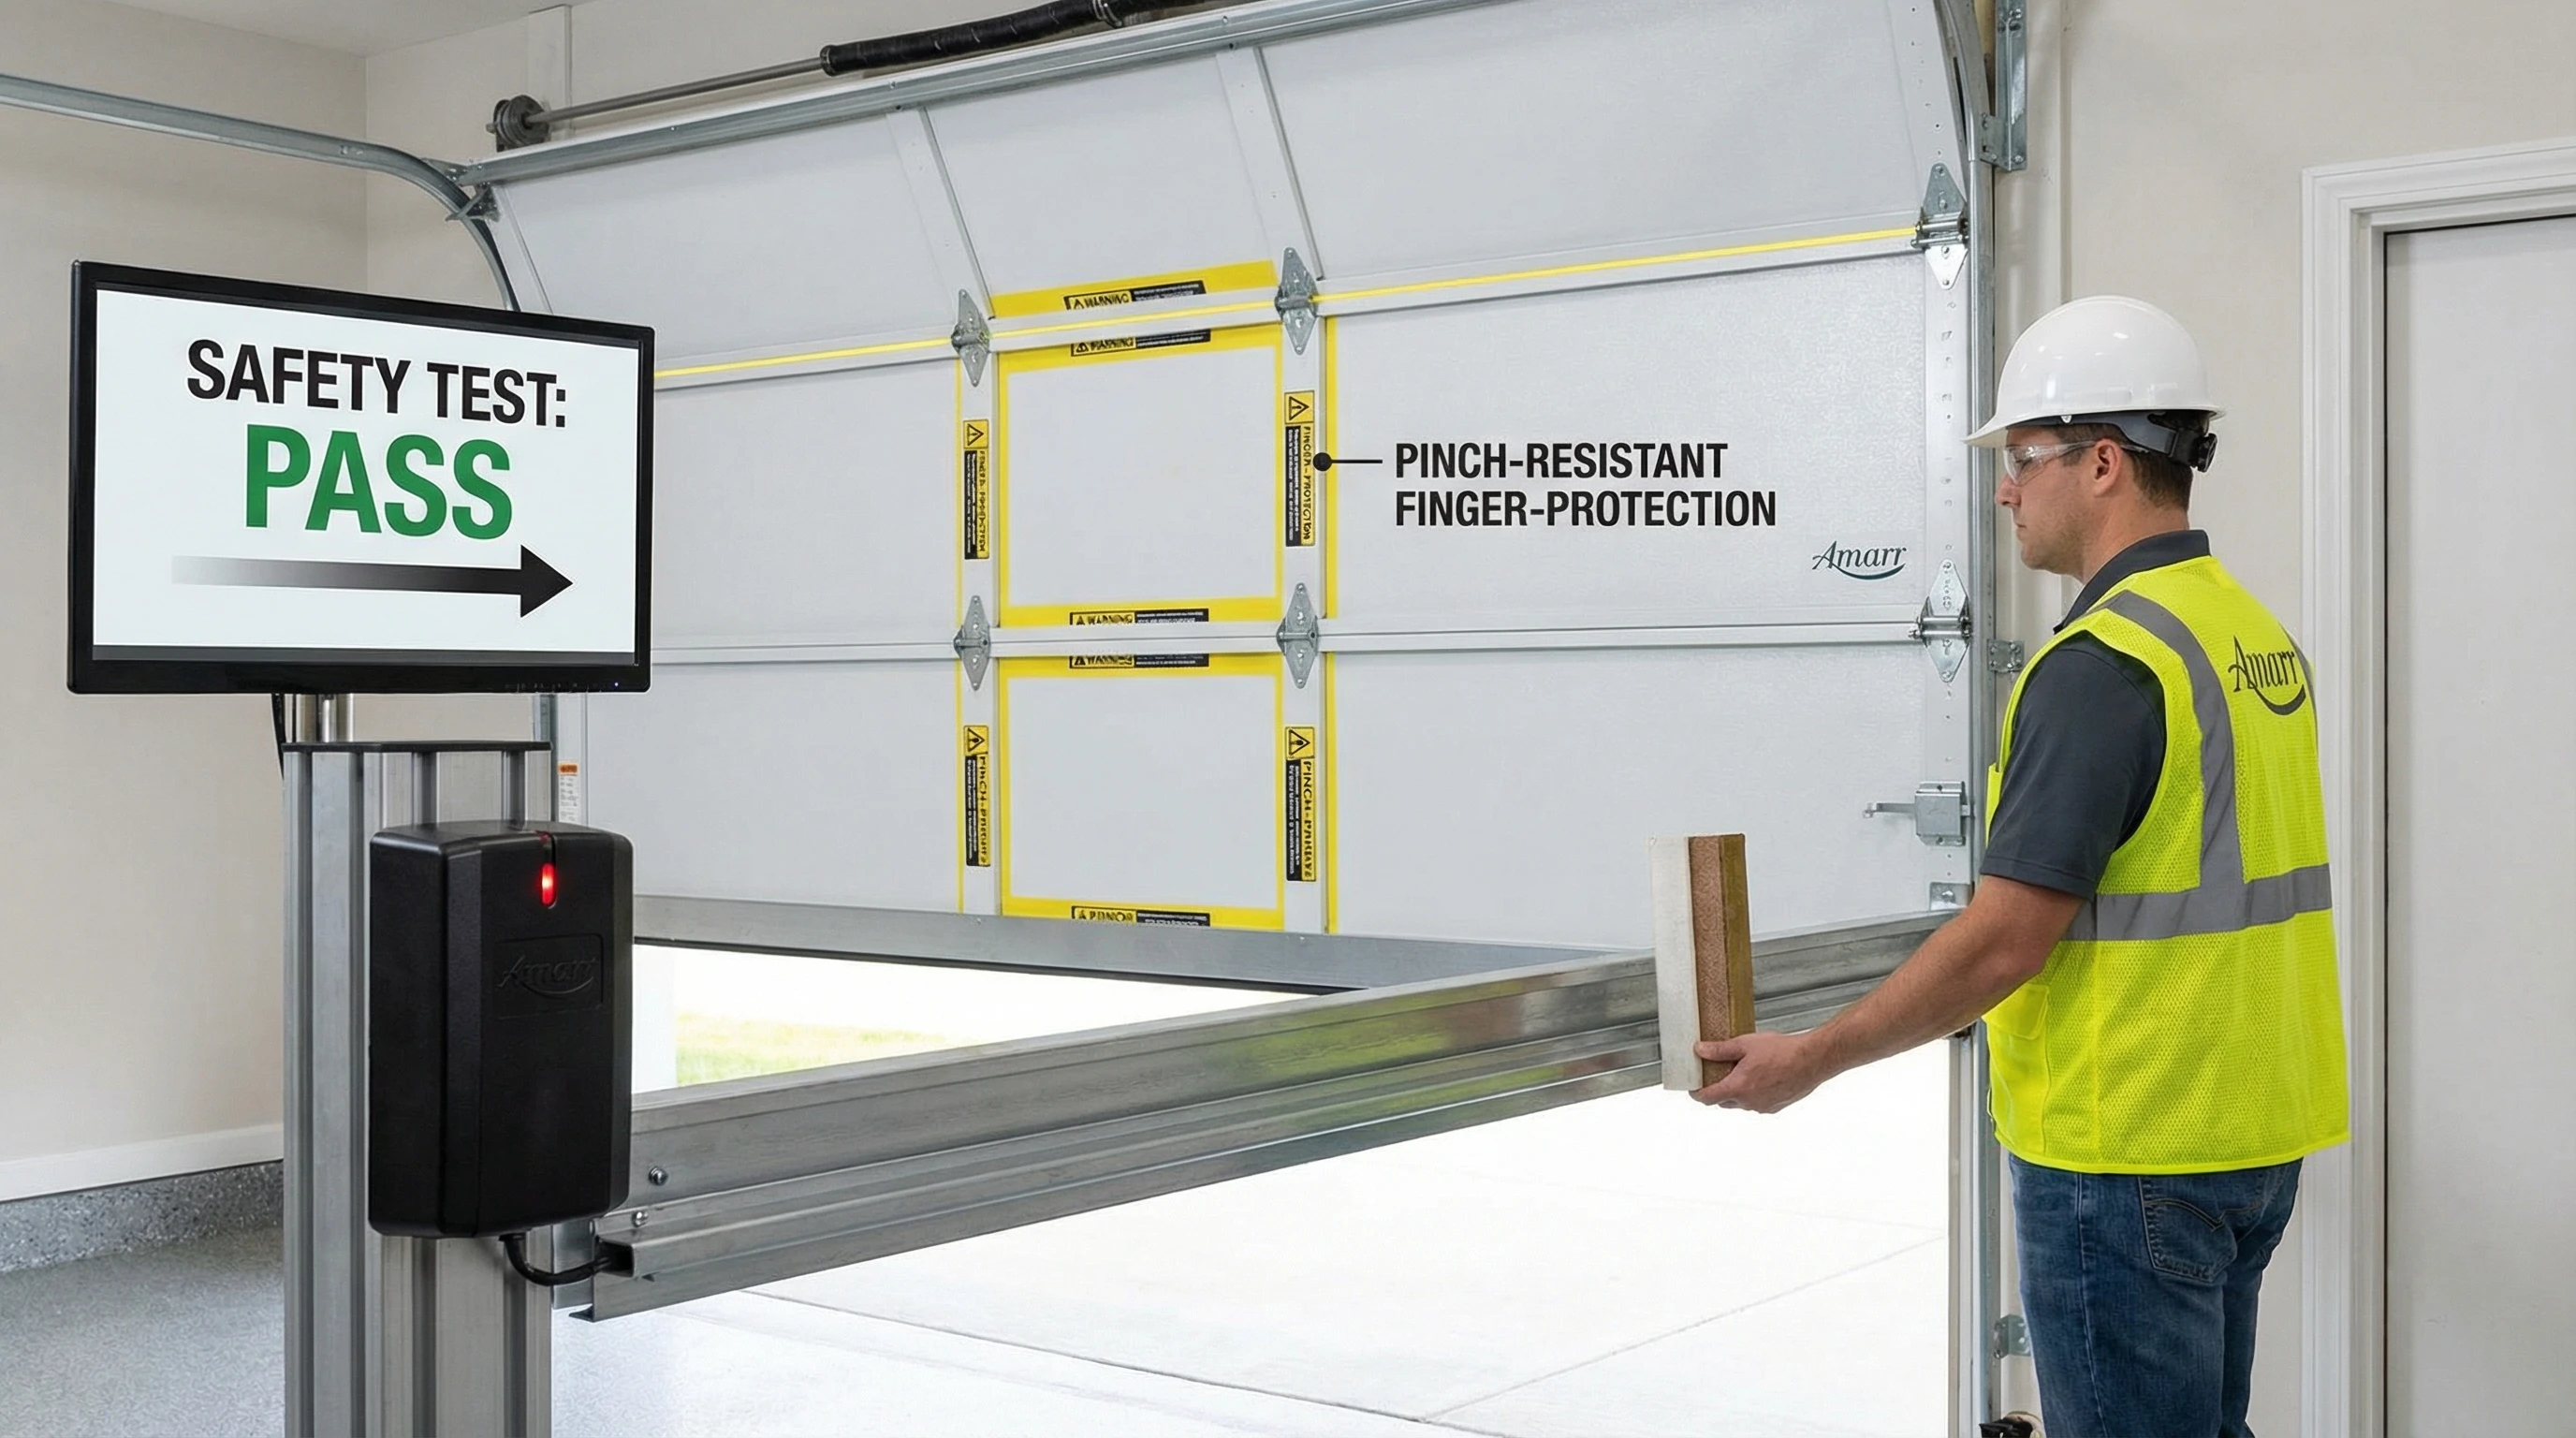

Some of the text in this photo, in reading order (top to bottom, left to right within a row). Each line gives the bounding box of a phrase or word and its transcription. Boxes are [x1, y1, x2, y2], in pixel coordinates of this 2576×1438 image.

[186, 339, 566, 428] SAFETY TEST:
[245, 423, 513, 539] PASS
[1812, 540, 1907, 580] Amarr
[2228, 635, 2306, 715] Amarr
